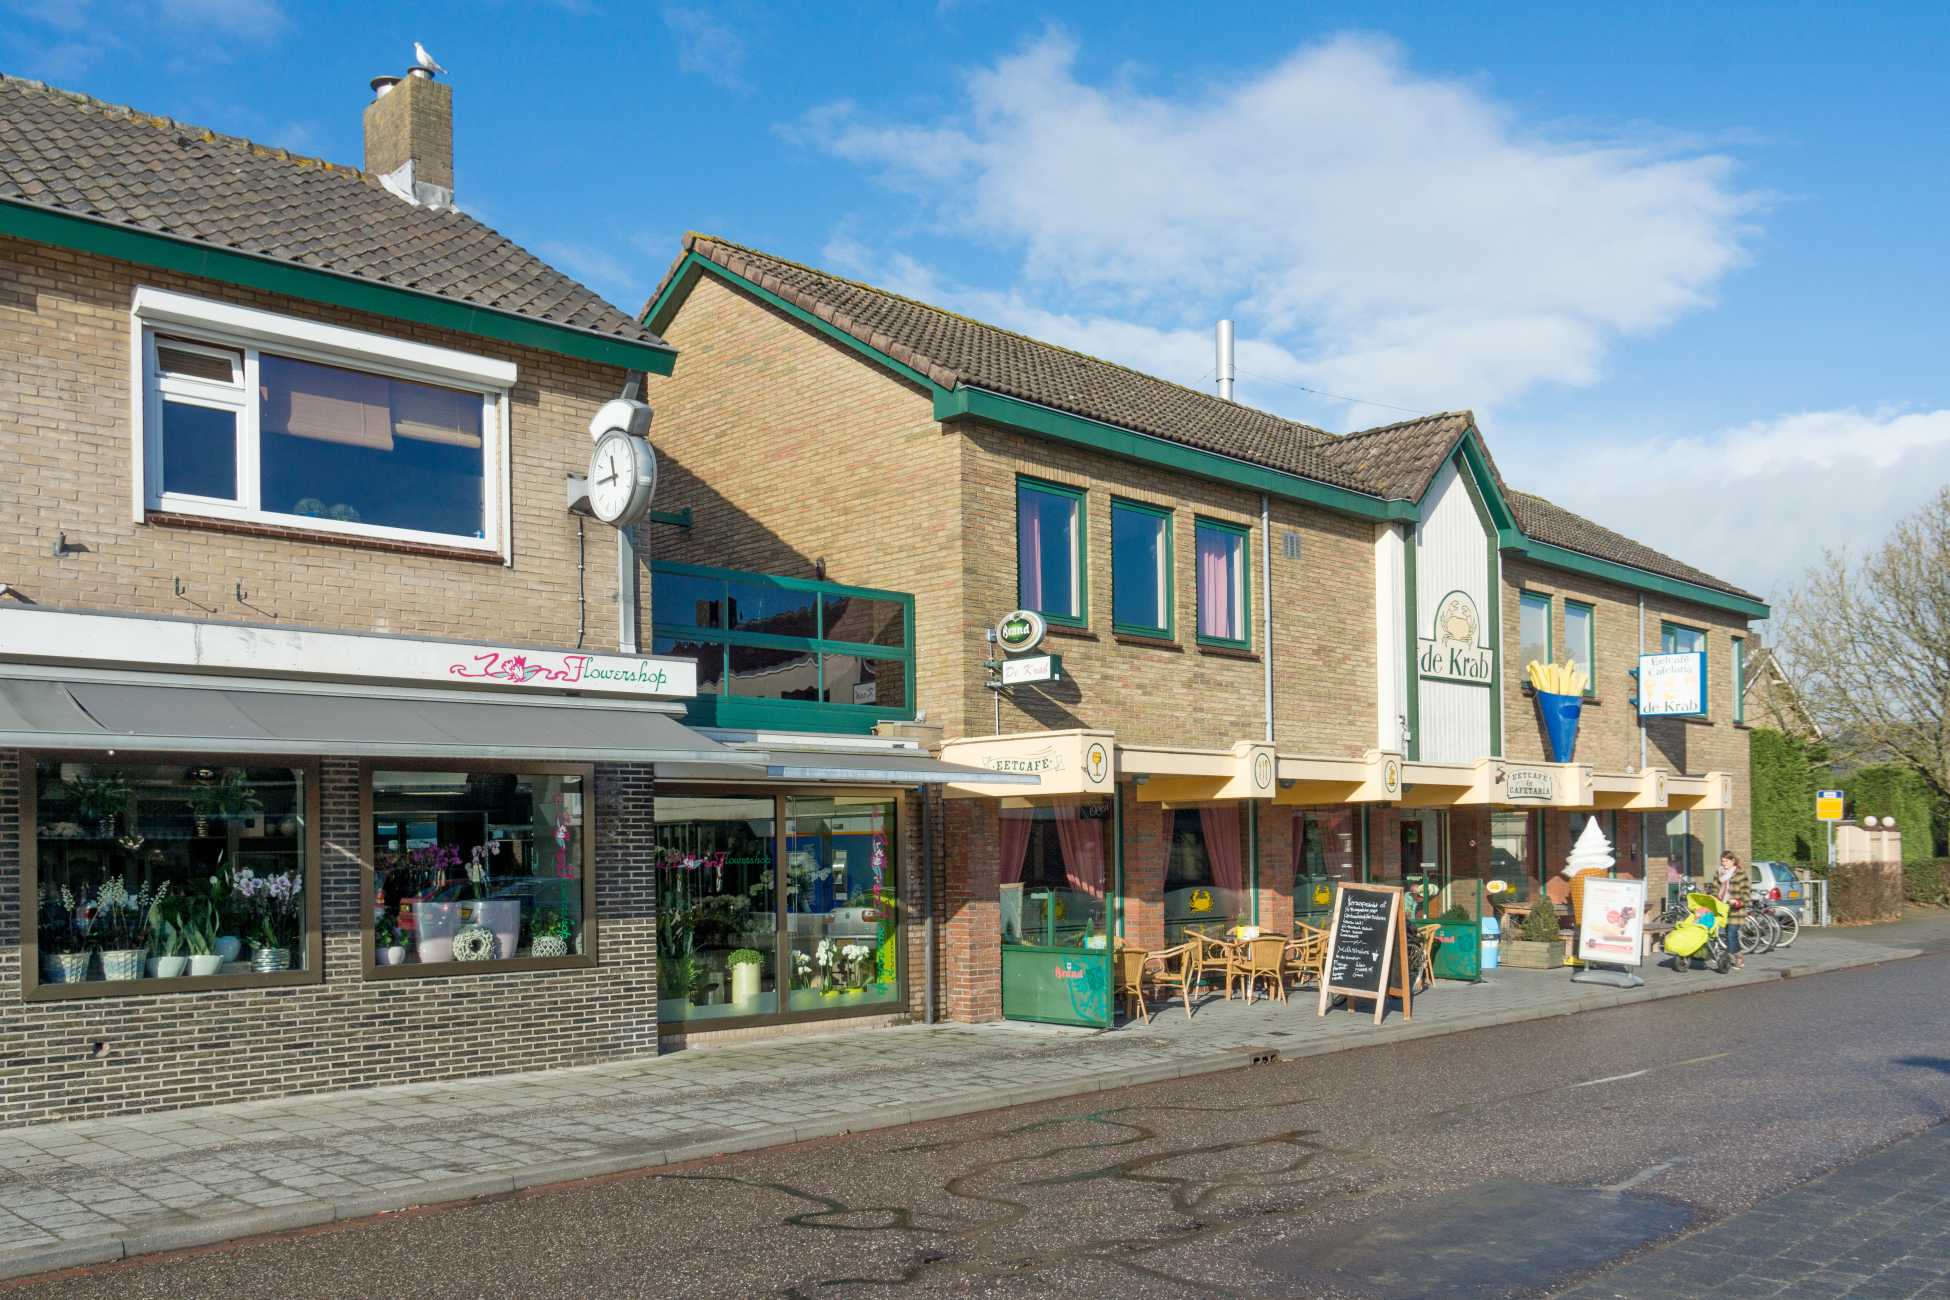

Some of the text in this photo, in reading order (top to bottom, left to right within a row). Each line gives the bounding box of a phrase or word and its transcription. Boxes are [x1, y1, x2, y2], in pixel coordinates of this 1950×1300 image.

[1002, 623, 1031, 639] Brand
[564, 655, 668, 692] Flowershop
[1421, 644, 1489, 679] de Krab
[1643, 699, 1698, 713] de Krab
